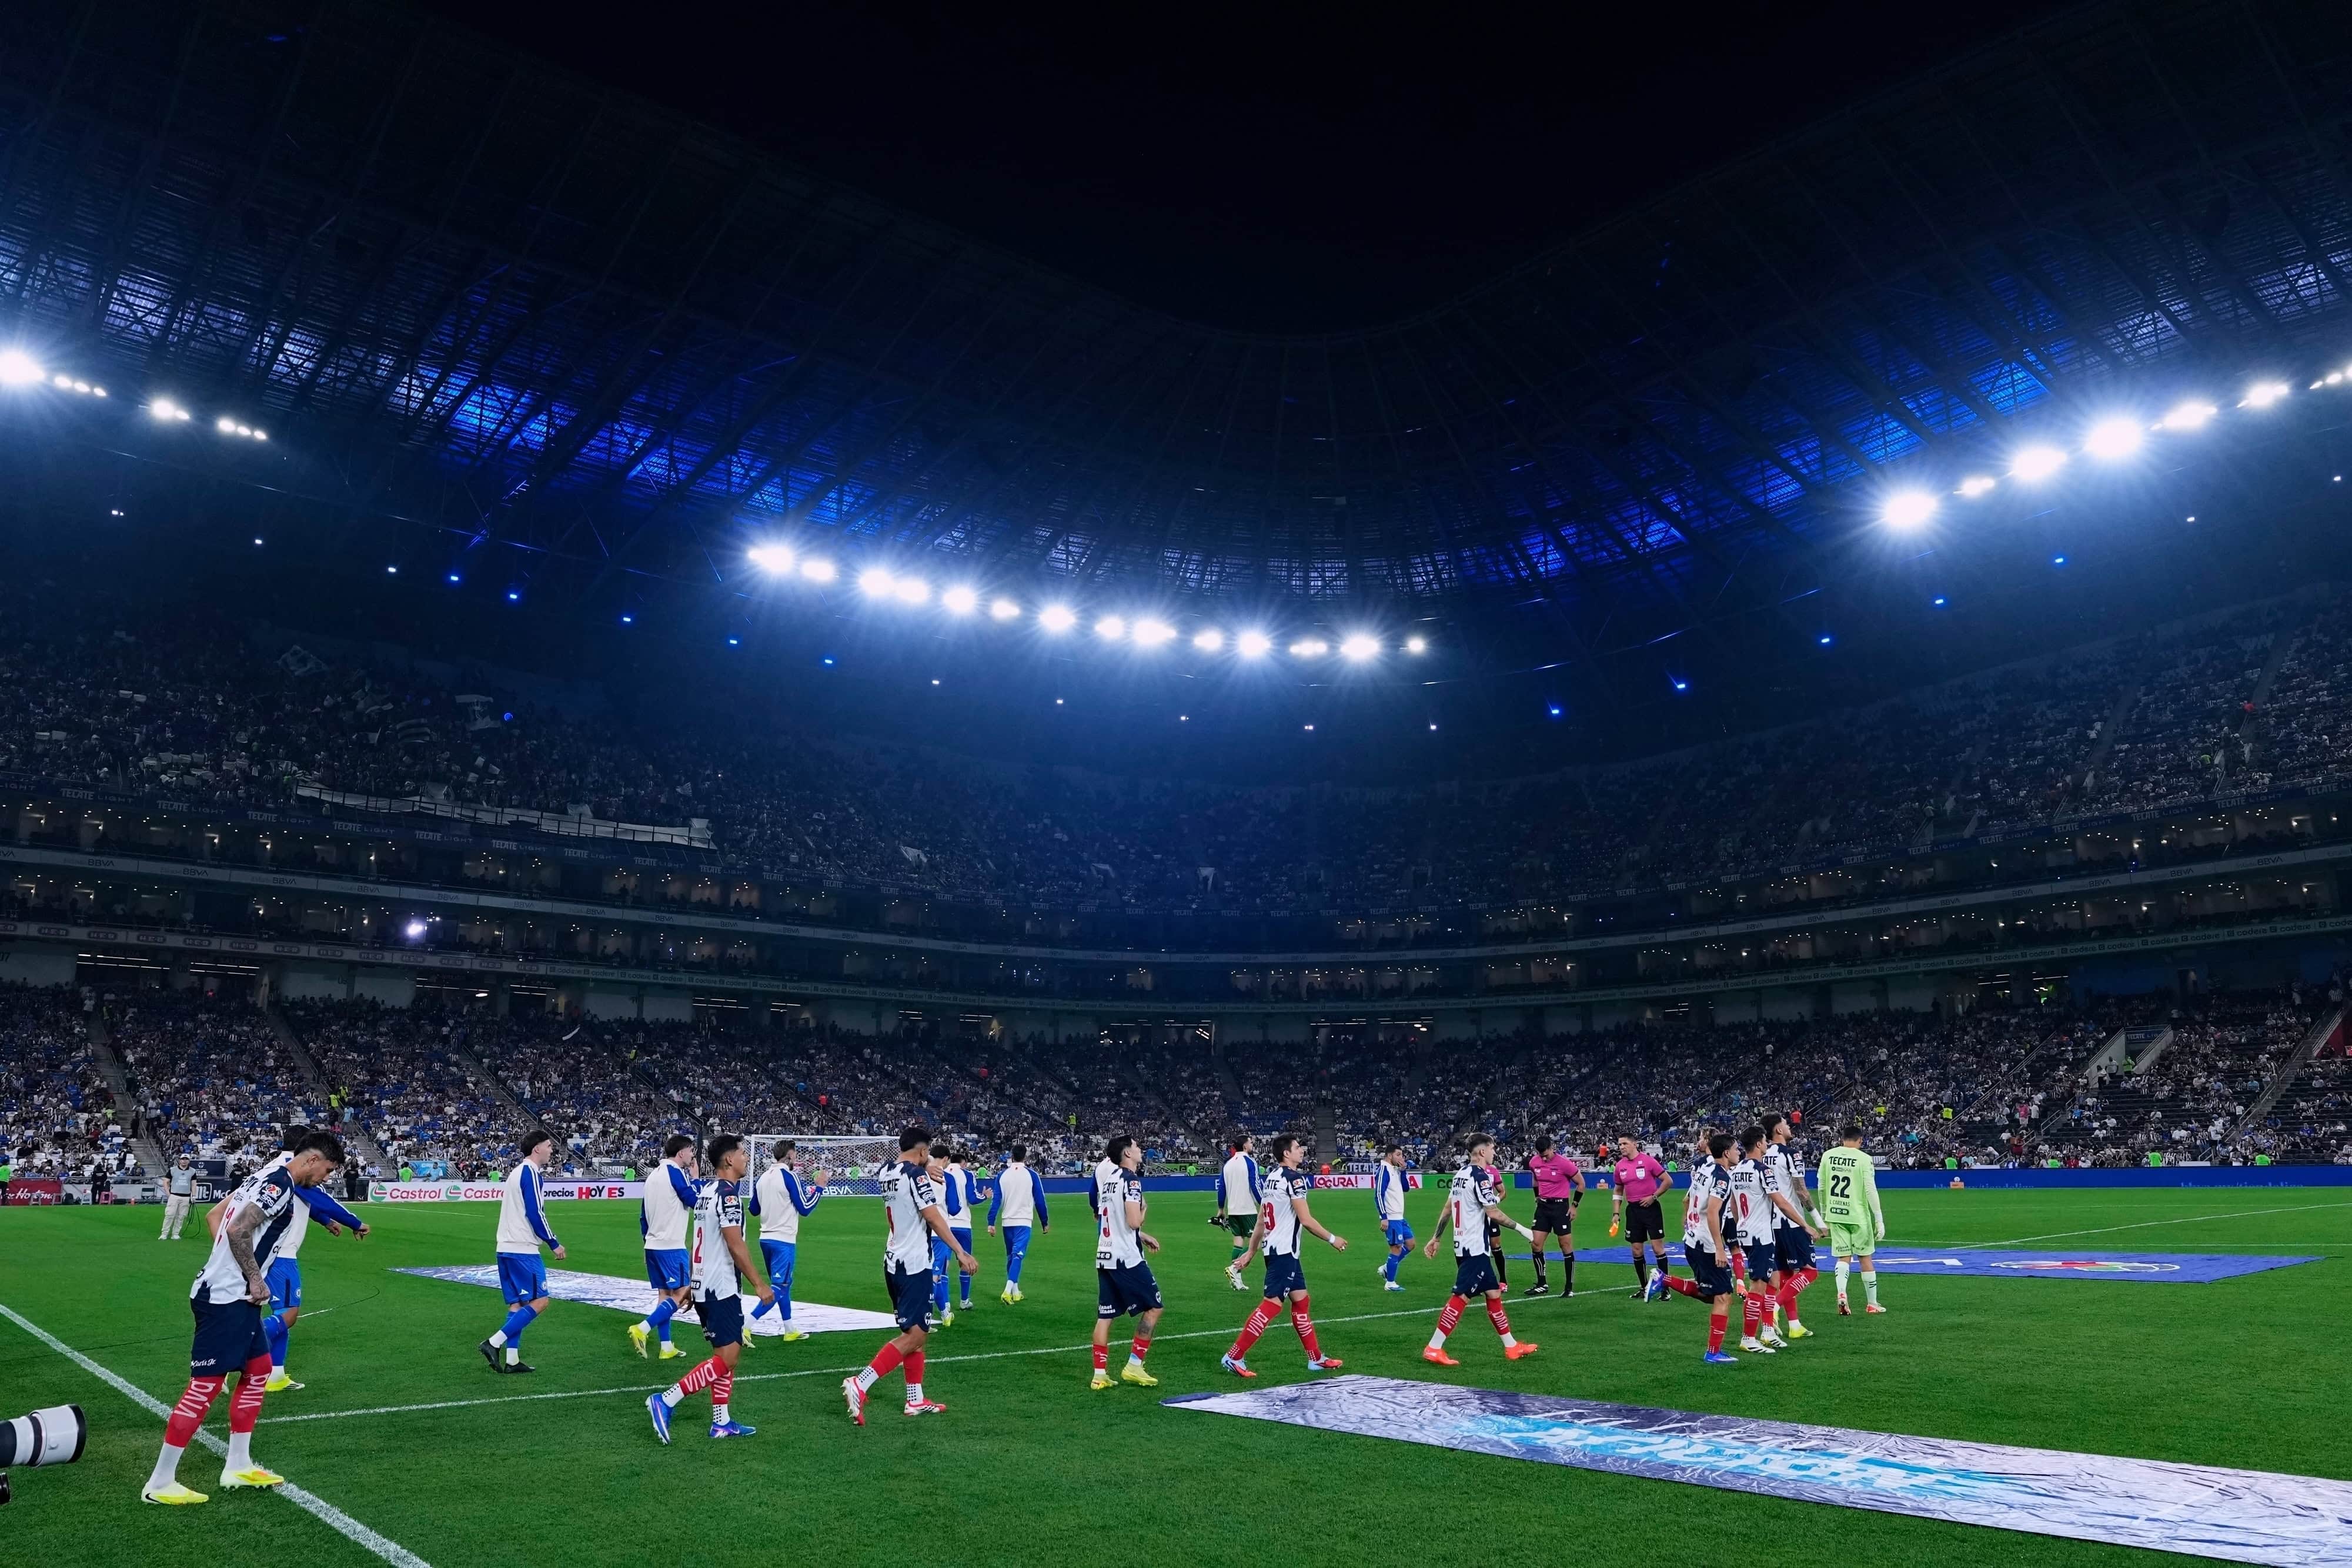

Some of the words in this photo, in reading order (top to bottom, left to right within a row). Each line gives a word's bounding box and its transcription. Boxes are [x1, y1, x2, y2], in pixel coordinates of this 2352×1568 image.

[2306, 784, 2338, 795] TECATE
[61, 787, 95, 800] TECATE
[97, 794, 133, 805] LIGHT
[2216, 798, 2247, 808] TECATE
[2249, 793, 2282, 803] LIGHT
[156, 800, 189, 811] TECATE
[191, 805, 226, 815] LIGHT
[247, 811, 277, 823] TECATE
[280, 817, 311, 826] LIGHT
[2131, 811, 2159, 821] TECATE
[2162, 806, 2194, 815] LIGHT
[334, 822, 362, 833] TECATE
[2053, 823, 2079, 833] TECATE
[2082, 818, 2112, 828] LIGHT
[415, 831, 442, 841] TECATE
[1978, 835, 2004, 845] TECATE
[2006, 831, 2033, 840] LIGHT
[492, 840, 517, 850] TECATE
[1907, 845, 1932, 855] TECATE
[1934, 842, 1961, 851] LIGHT
[564, 848, 588, 858] TECATE
[1842, 855, 1865, 864] TECATE
[1866, 852, 1892, 862] LIGHT
[88, 858, 114, 867] BBVA
[634, 857, 657, 867] TECATE
[2257, 856, 2283, 865] BBVA
[183, 868, 208, 877] BBVA
[700, 865, 722, 874] TECATE
[1780, 865, 1802, 874] TECATE
[2170, 868, 2193, 877] BBVA
[764, 872, 784, 881] TECATE
[1721, 874, 1740, 883] TECATE
[823, 880, 843, 889] TECATE
[1666, 882, 1687, 891] TECATE
[2089, 879, 2111, 887] BBVA
[881, 886, 899, 895] TECATE
[1616, 888, 1636, 897] TECATE
[936, 893, 954, 902] TECATE
[1568, 894, 1588, 902] TECATE
[1469, 902, 1488, 910] TECATE
[2237, 928, 2267, 937] codere
[2280, 924, 2311, 932] codere
[2191, 933, 2220, 941] codere
[2029, 949, 2055, 957] codere
[1829, 1156, 1857, 1167] TECATE
[1830, 1175, 1850, 1199] 22
[389, 1188, 441, 1199] Castrol
[608, 1187, 624, 1198] ES
[1102, 1206, 1110, 1238] 3
[694, 1226, 703, 1263] 2
